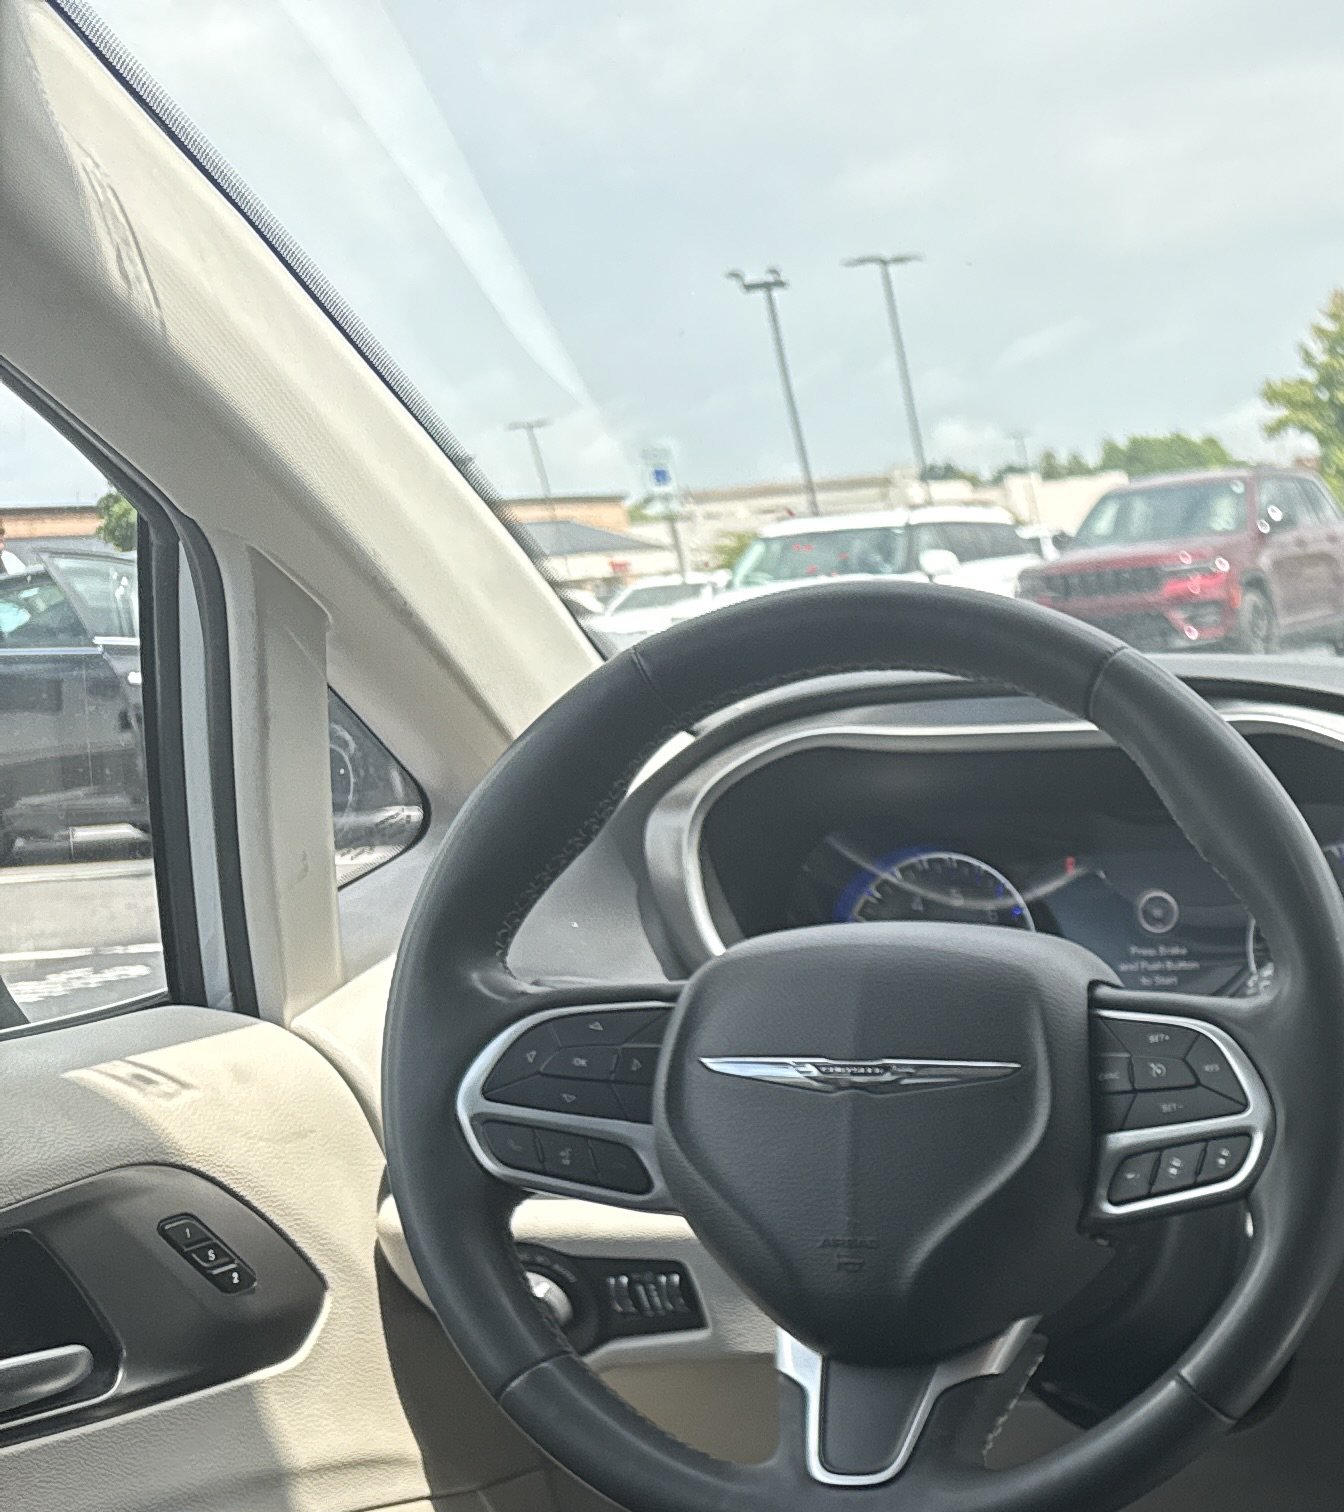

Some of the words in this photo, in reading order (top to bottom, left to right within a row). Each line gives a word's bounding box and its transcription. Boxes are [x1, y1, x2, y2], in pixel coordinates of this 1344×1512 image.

[572, 1056, 588, 1068] OK
[185, 1227, 192, 1239] 1
[207, 1248, 216, 1261] S
[231, 1271, 240, 1284] 2
